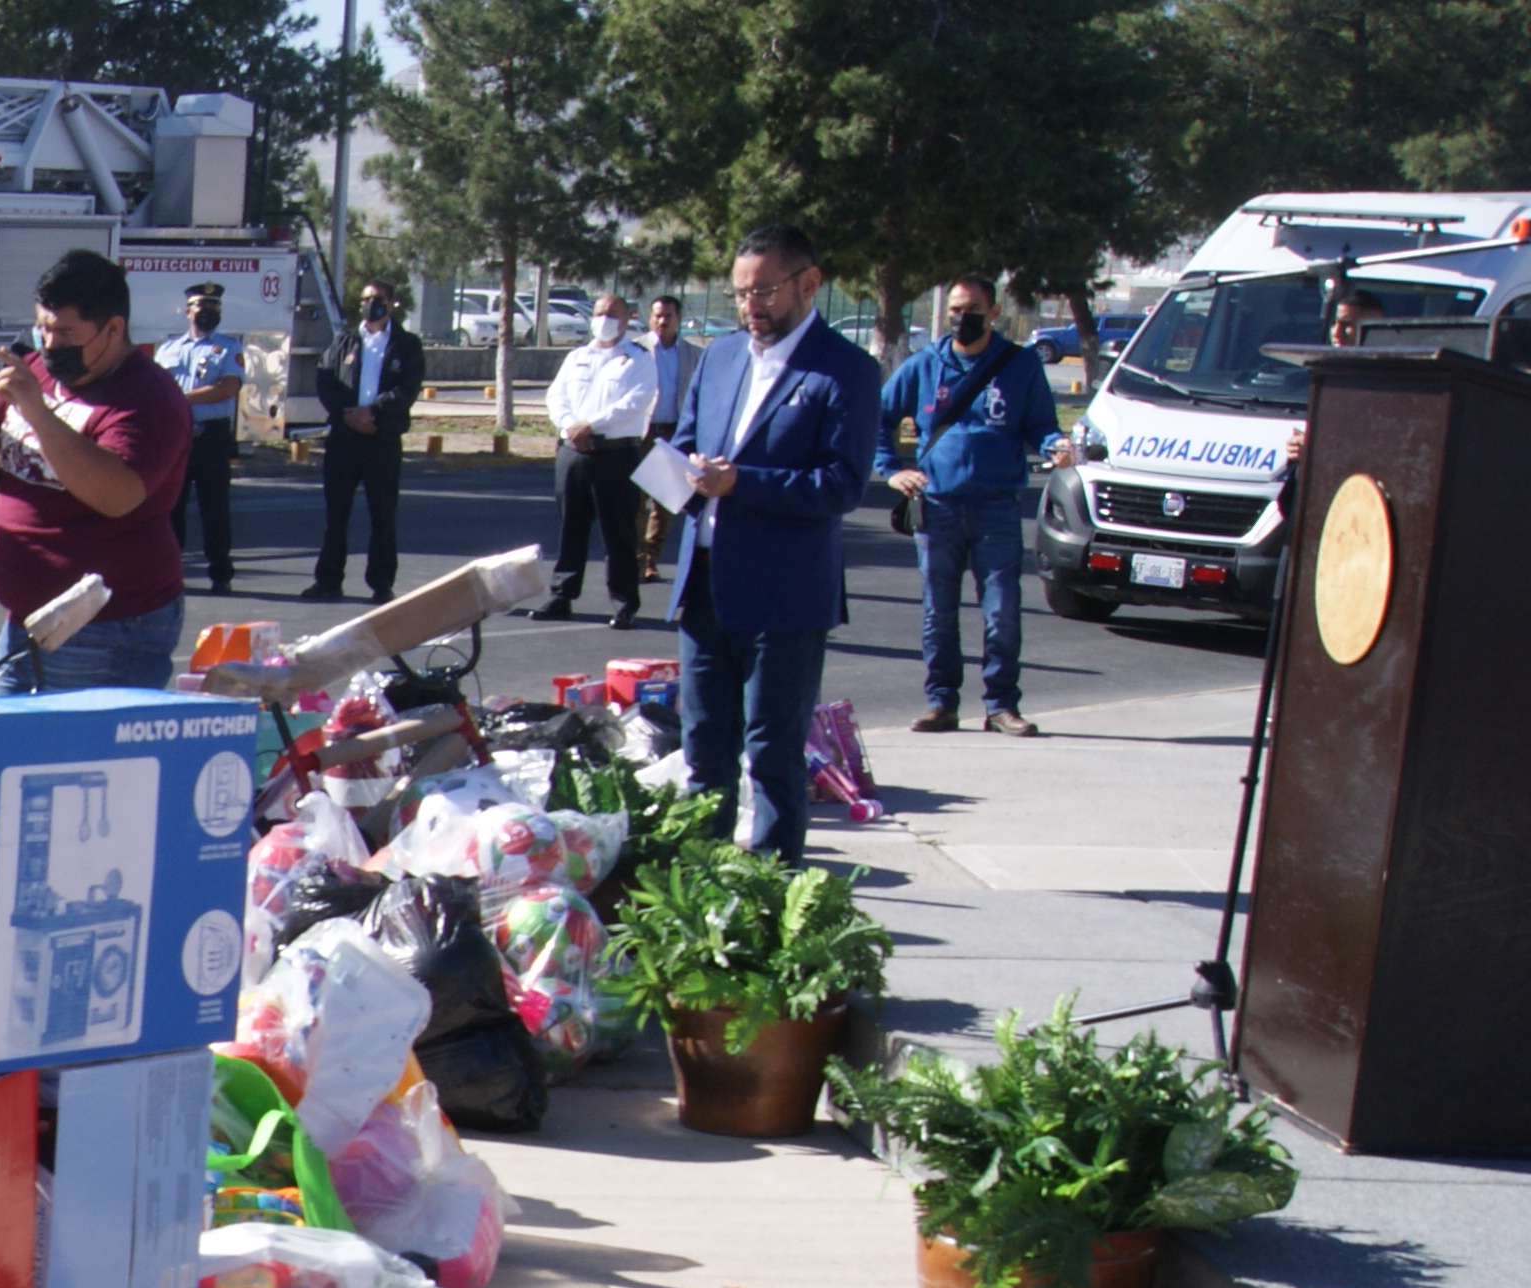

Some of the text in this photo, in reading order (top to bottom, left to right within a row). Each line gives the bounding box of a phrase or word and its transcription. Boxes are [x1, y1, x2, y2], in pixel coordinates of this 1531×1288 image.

[124, 258, 257, 272] PROTECCION CIVIL
[262, 276, 281, 298] 03
[115, 713, 258, 744] MOLTO KITCHEN
